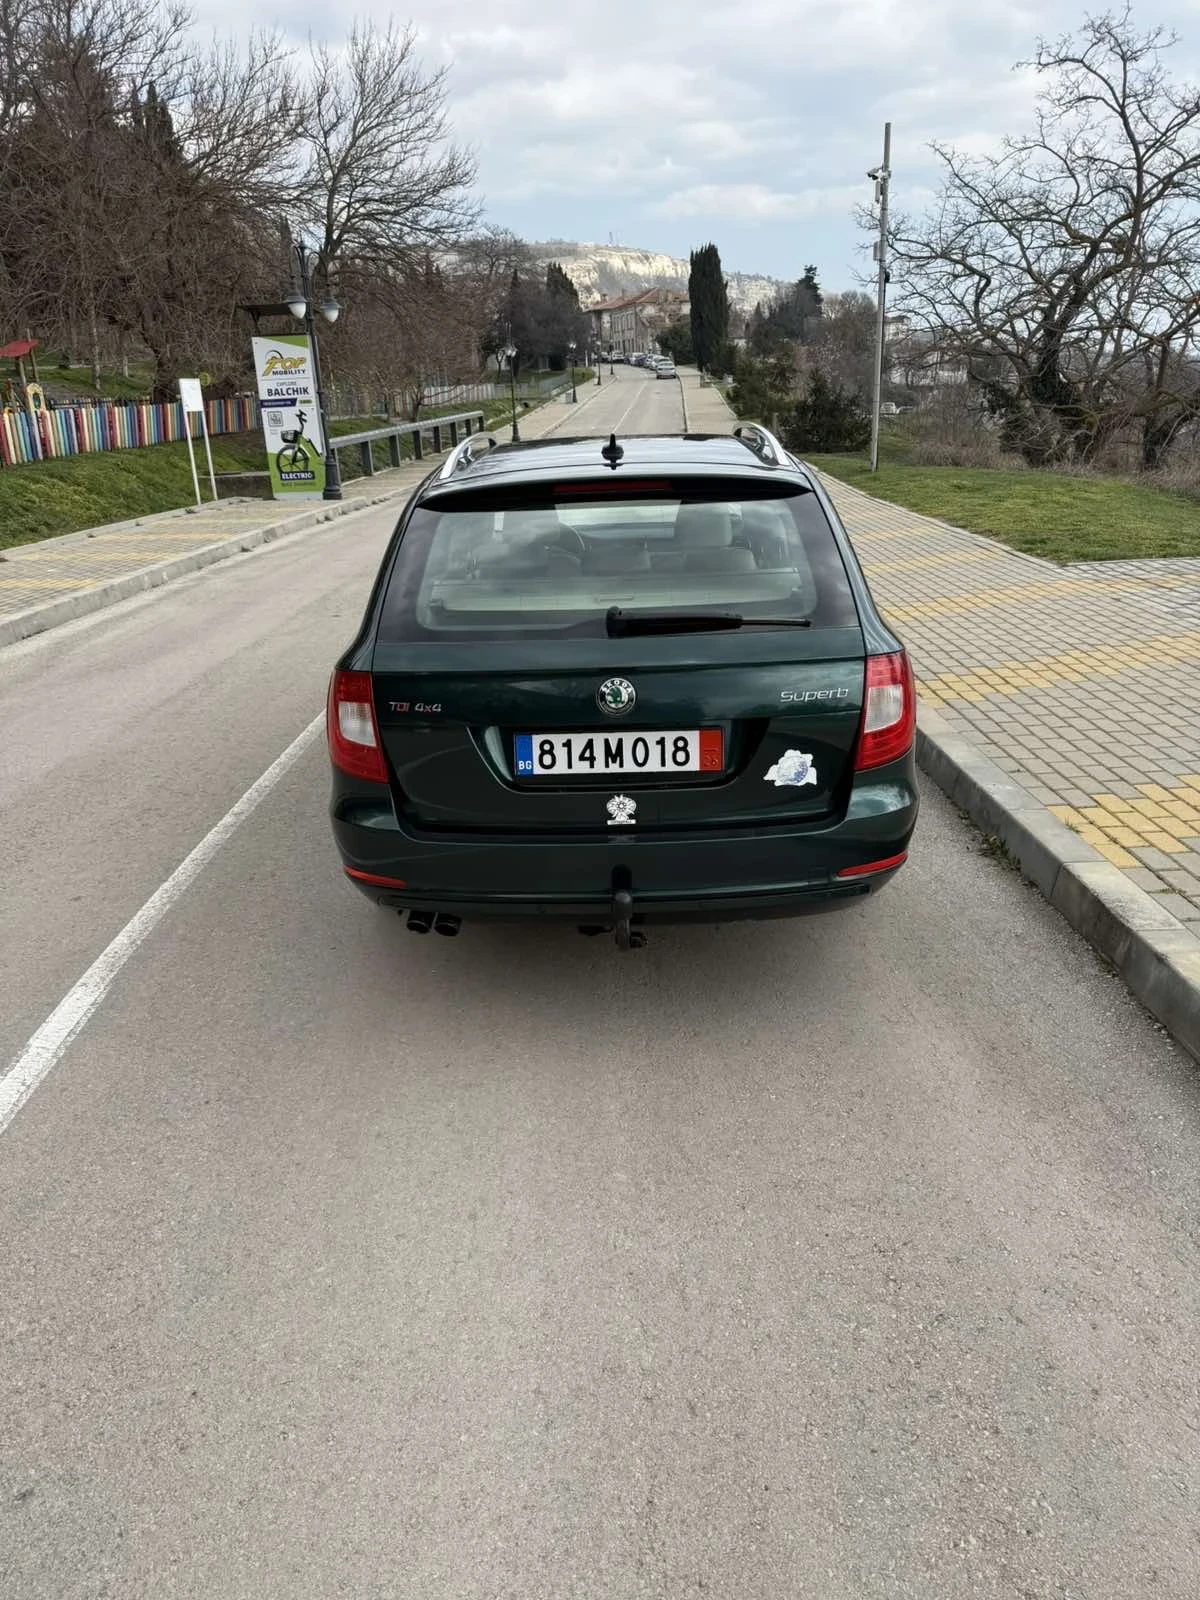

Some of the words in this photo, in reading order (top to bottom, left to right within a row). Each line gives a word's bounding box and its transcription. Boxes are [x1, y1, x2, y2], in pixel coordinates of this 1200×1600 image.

[262, 356, 306, 376] TOP
[267, 387, 309, 396] BALCHIK
[780, 688, 849, 702] Superb
[388, 702, 411, 711] TDI
[415, 703, 442, 712] 4x4
[518, 760, 532, 770] BG
